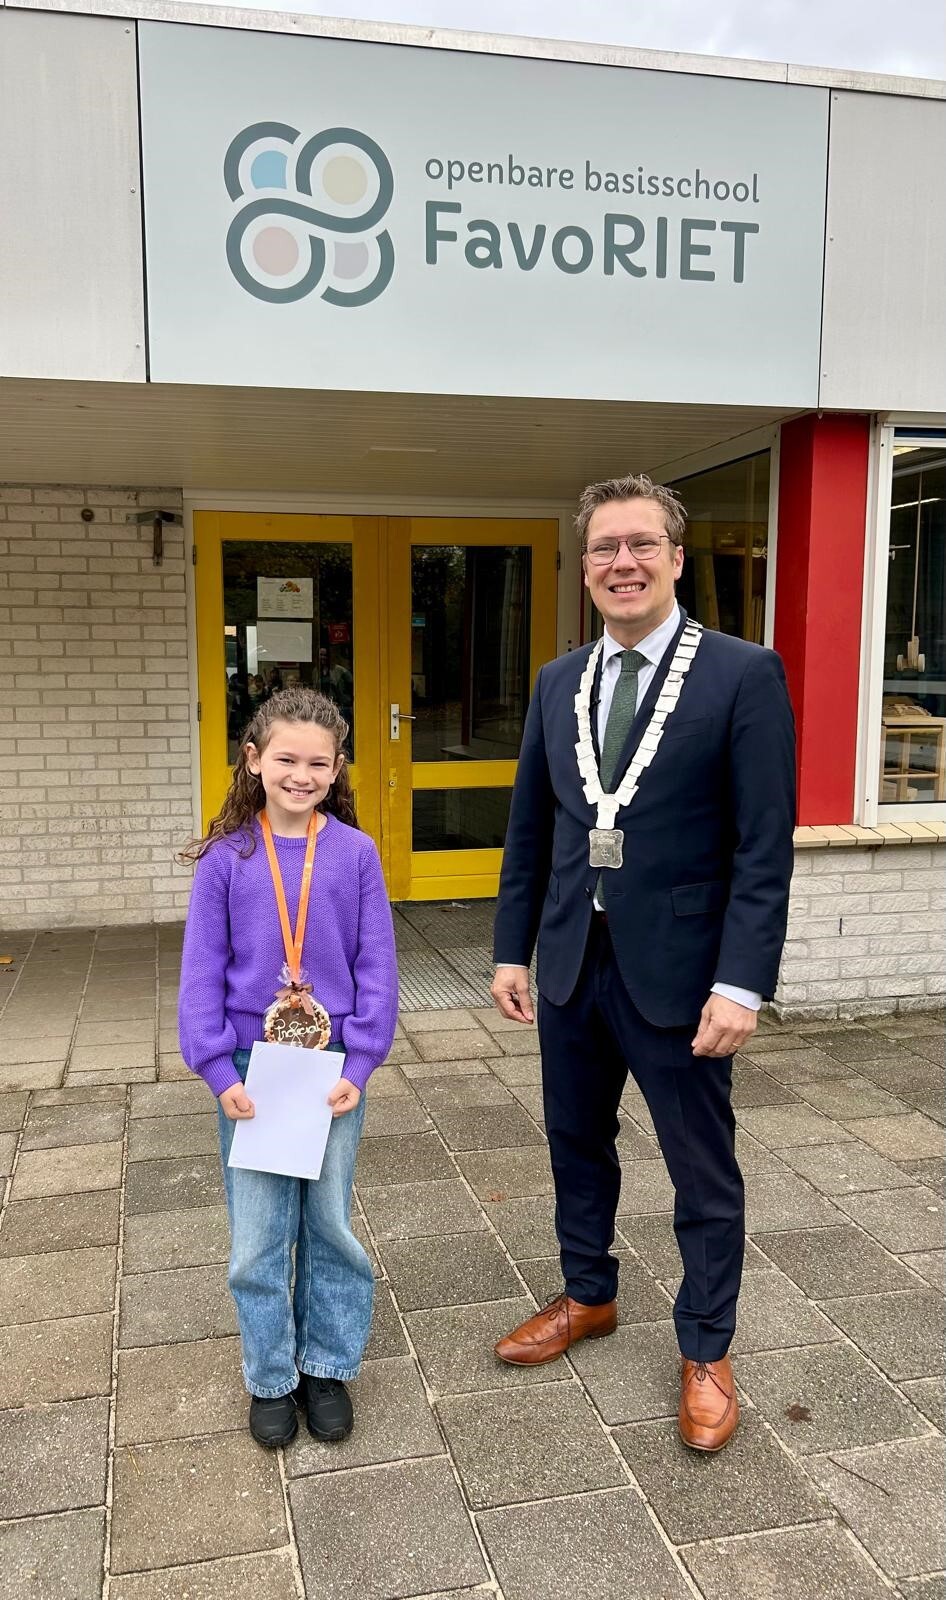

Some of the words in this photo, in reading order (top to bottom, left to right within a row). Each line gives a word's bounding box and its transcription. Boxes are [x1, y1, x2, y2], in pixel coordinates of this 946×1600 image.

[425, 154, 574, 190] openbare
[585, 160, 760, 203] basisschool
[425, 200, 760, 284] FavoRIET
